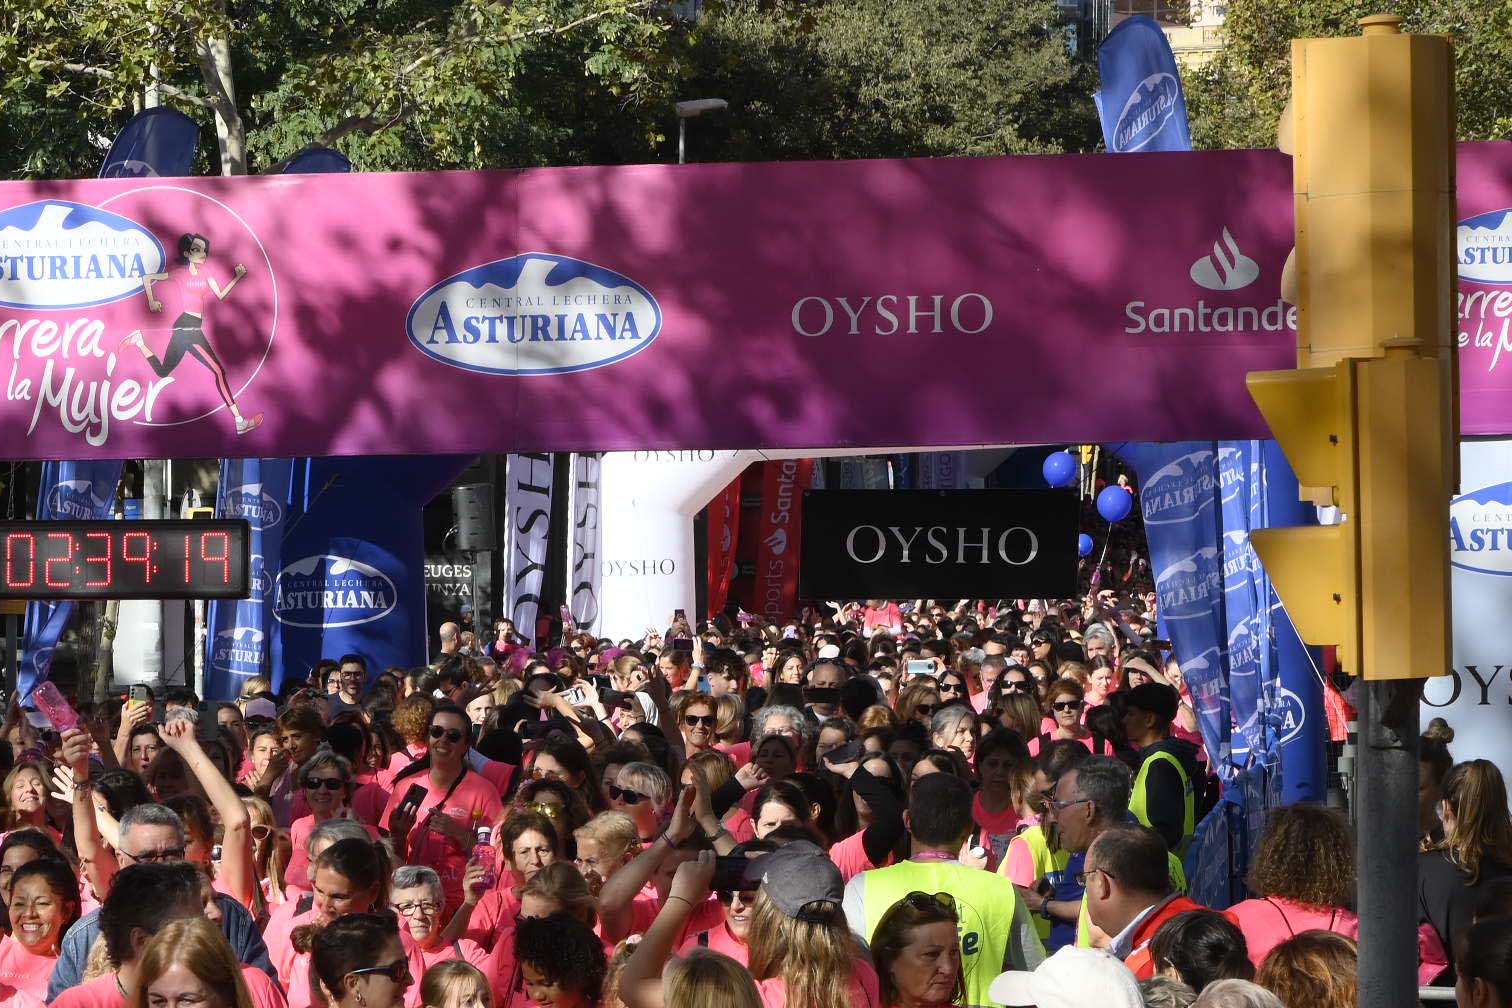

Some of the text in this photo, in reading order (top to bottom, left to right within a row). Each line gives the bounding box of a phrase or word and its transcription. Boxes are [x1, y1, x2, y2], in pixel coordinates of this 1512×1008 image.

[465, 293, 633, 308] CENTRAL LECHERA
[791, 292, 995, 337] OYSHO
[1124, 300, 1299, 334] Santande
[426, 299, 642, 345] ASTURIANA
[1474, 319, 1494, 348] la
[6, 361, 32, 401] la
[26, 353, 175, 447] Mujer
[4, 532, 232, 589] 02:39:19
[845, 524, 1040, 567] OYSHO
[600, 558, 676, 578] OYSHO
[275, 585, 388, 612] ASTURIANA
